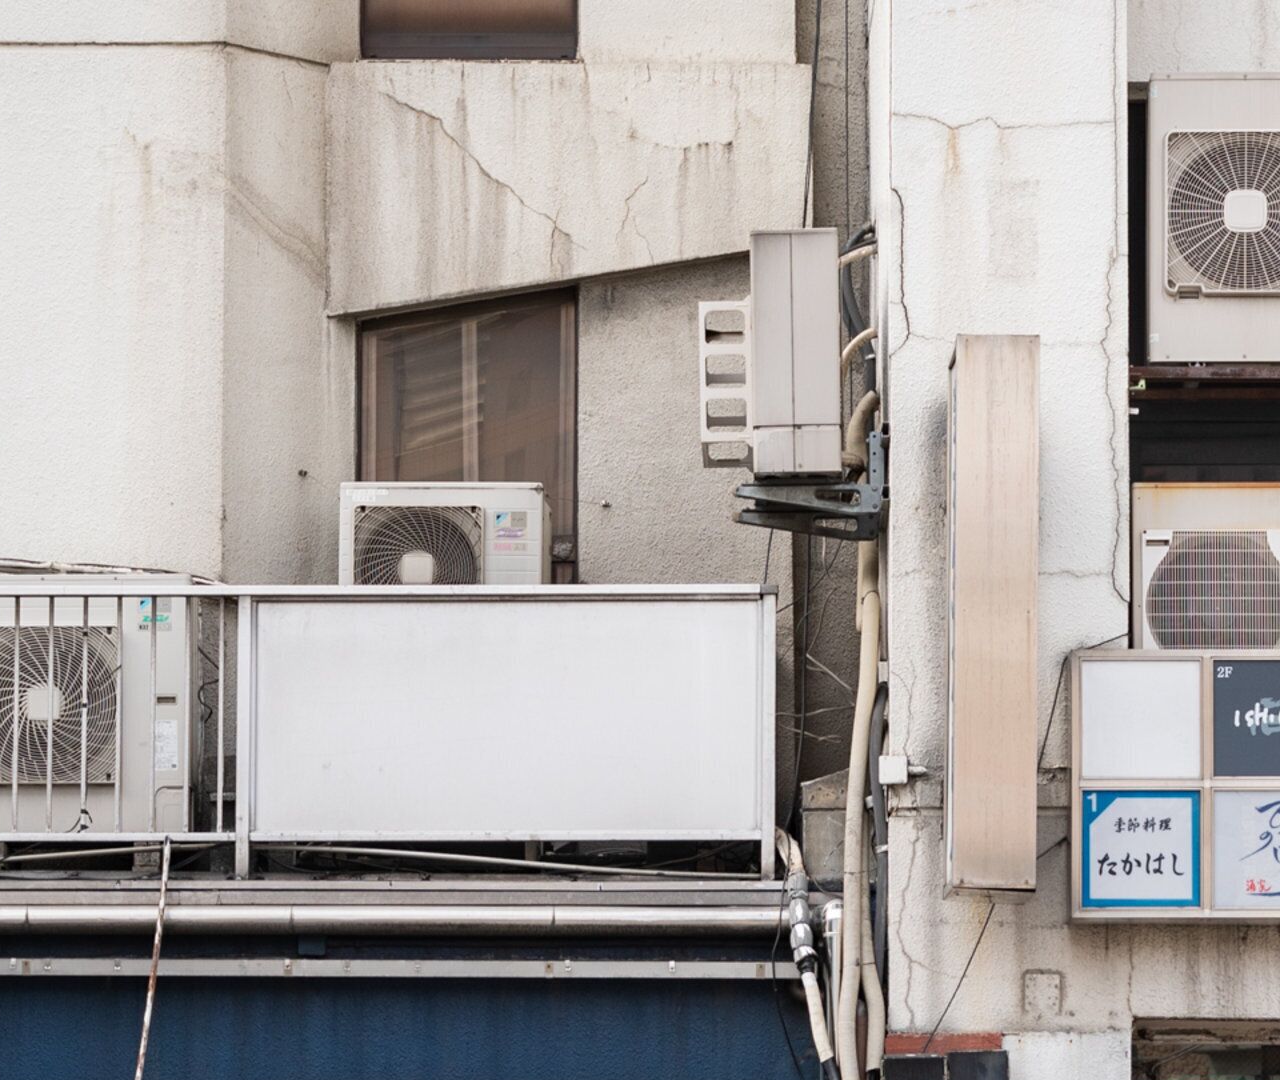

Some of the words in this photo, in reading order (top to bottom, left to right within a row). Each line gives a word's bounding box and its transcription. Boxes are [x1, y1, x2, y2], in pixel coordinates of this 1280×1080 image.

[1217, 666, 1233, 678] 2F
[1086, 793, 1097, 812] 1
[1114, 817, 1172, 833] 季節料理
[1097, 852, 1185, 876] たかはし
